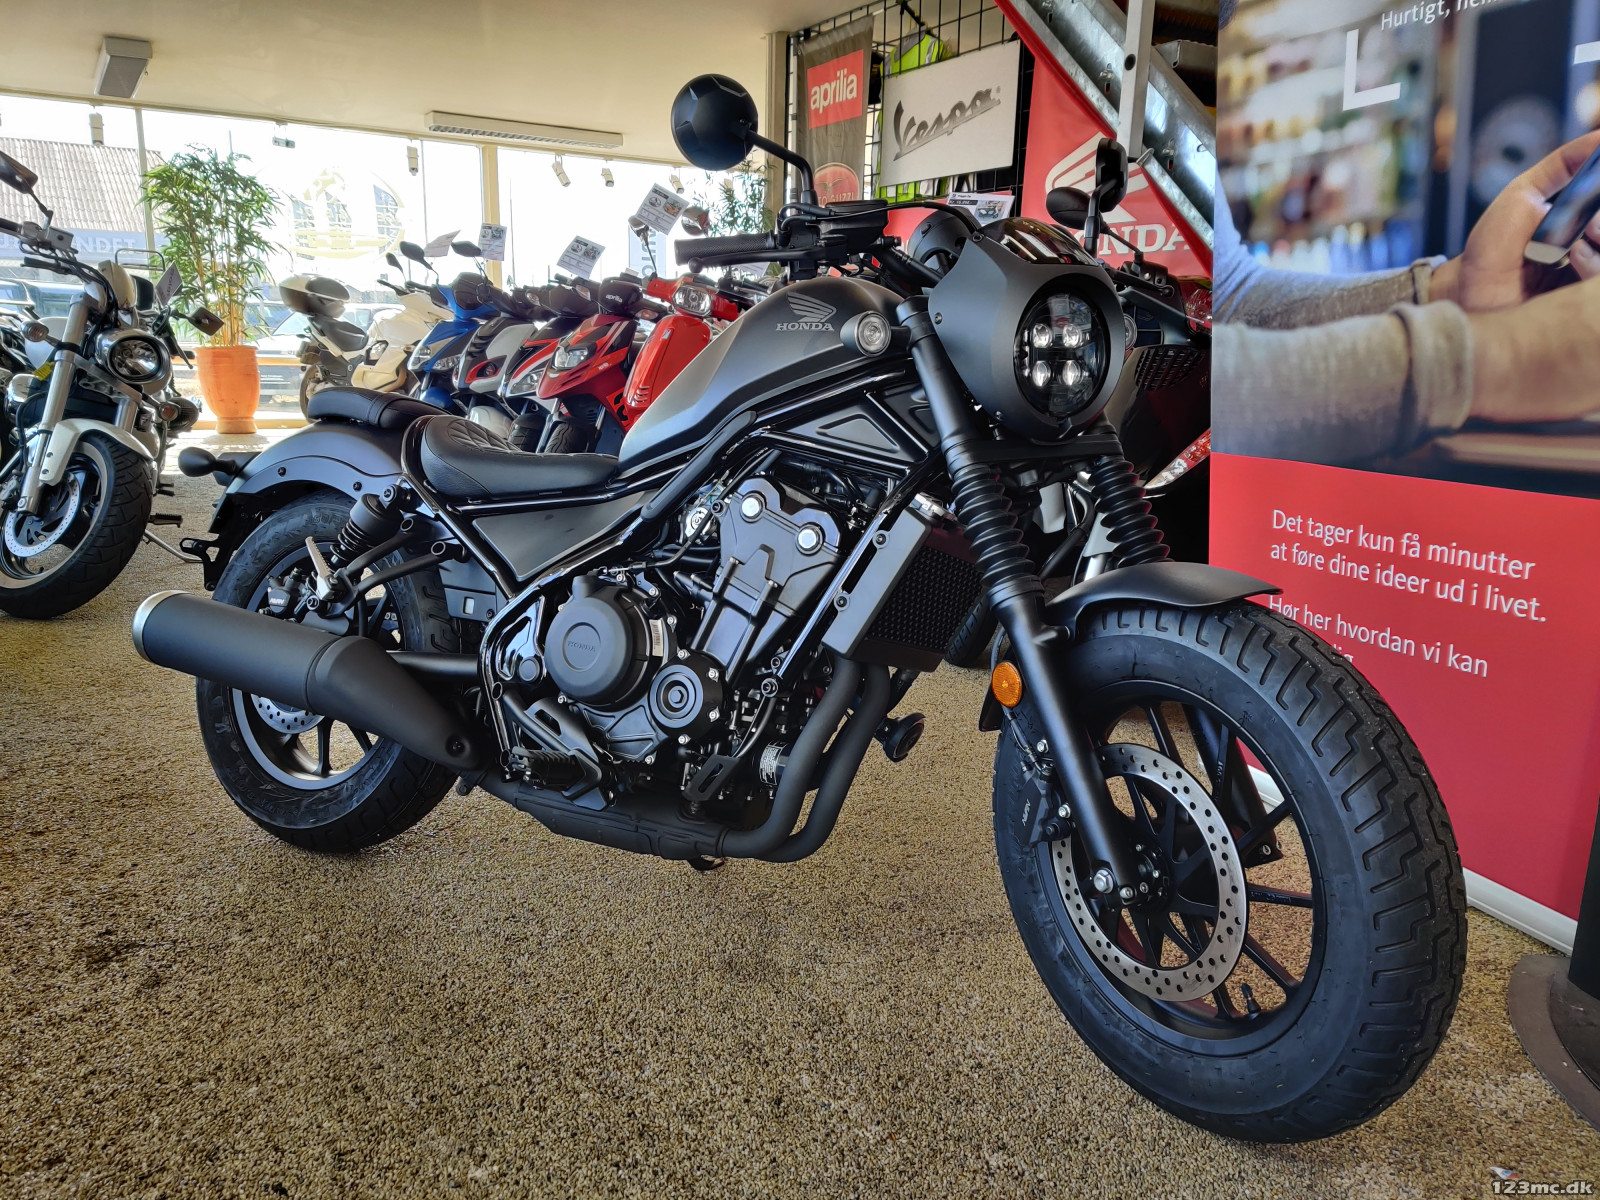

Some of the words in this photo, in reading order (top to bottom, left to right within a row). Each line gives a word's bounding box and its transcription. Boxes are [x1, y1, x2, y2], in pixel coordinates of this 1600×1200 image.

[1381, 0, 1451, 31] Hurtigt,
[810, 67, 858, 115] aprilia
[893, 88, 1001, 161] Vespa
[776, 322, 835, 331] HONDA
[1272, 509, 1303, 534] Det
[1307, 517, 1354, 547] tager
[1358, 524, 1395, 553] kun
[1400, 532, 1421, 558] få
[1428, 542, 1536, 580] minutter
[1270, 543, 1288, 561] at
[1292, 542, 1325, 571] føre
[1329, 552, 1370, 581] dine
[1375, 562, 1430, 594] ideer
[1435, 578, 1465, 603] ud
[1471, 582, 1479, 606] i
[1485, 584, 1547, 622] livet.
[1269, 594, 1299, 621] Hør
[1303, 603, 1332, 631] her
[1336, 613, 1416, 657] hvordan
[1422, 641, 1441, 664] vi
[1447, 643, 1488, 678] kan
